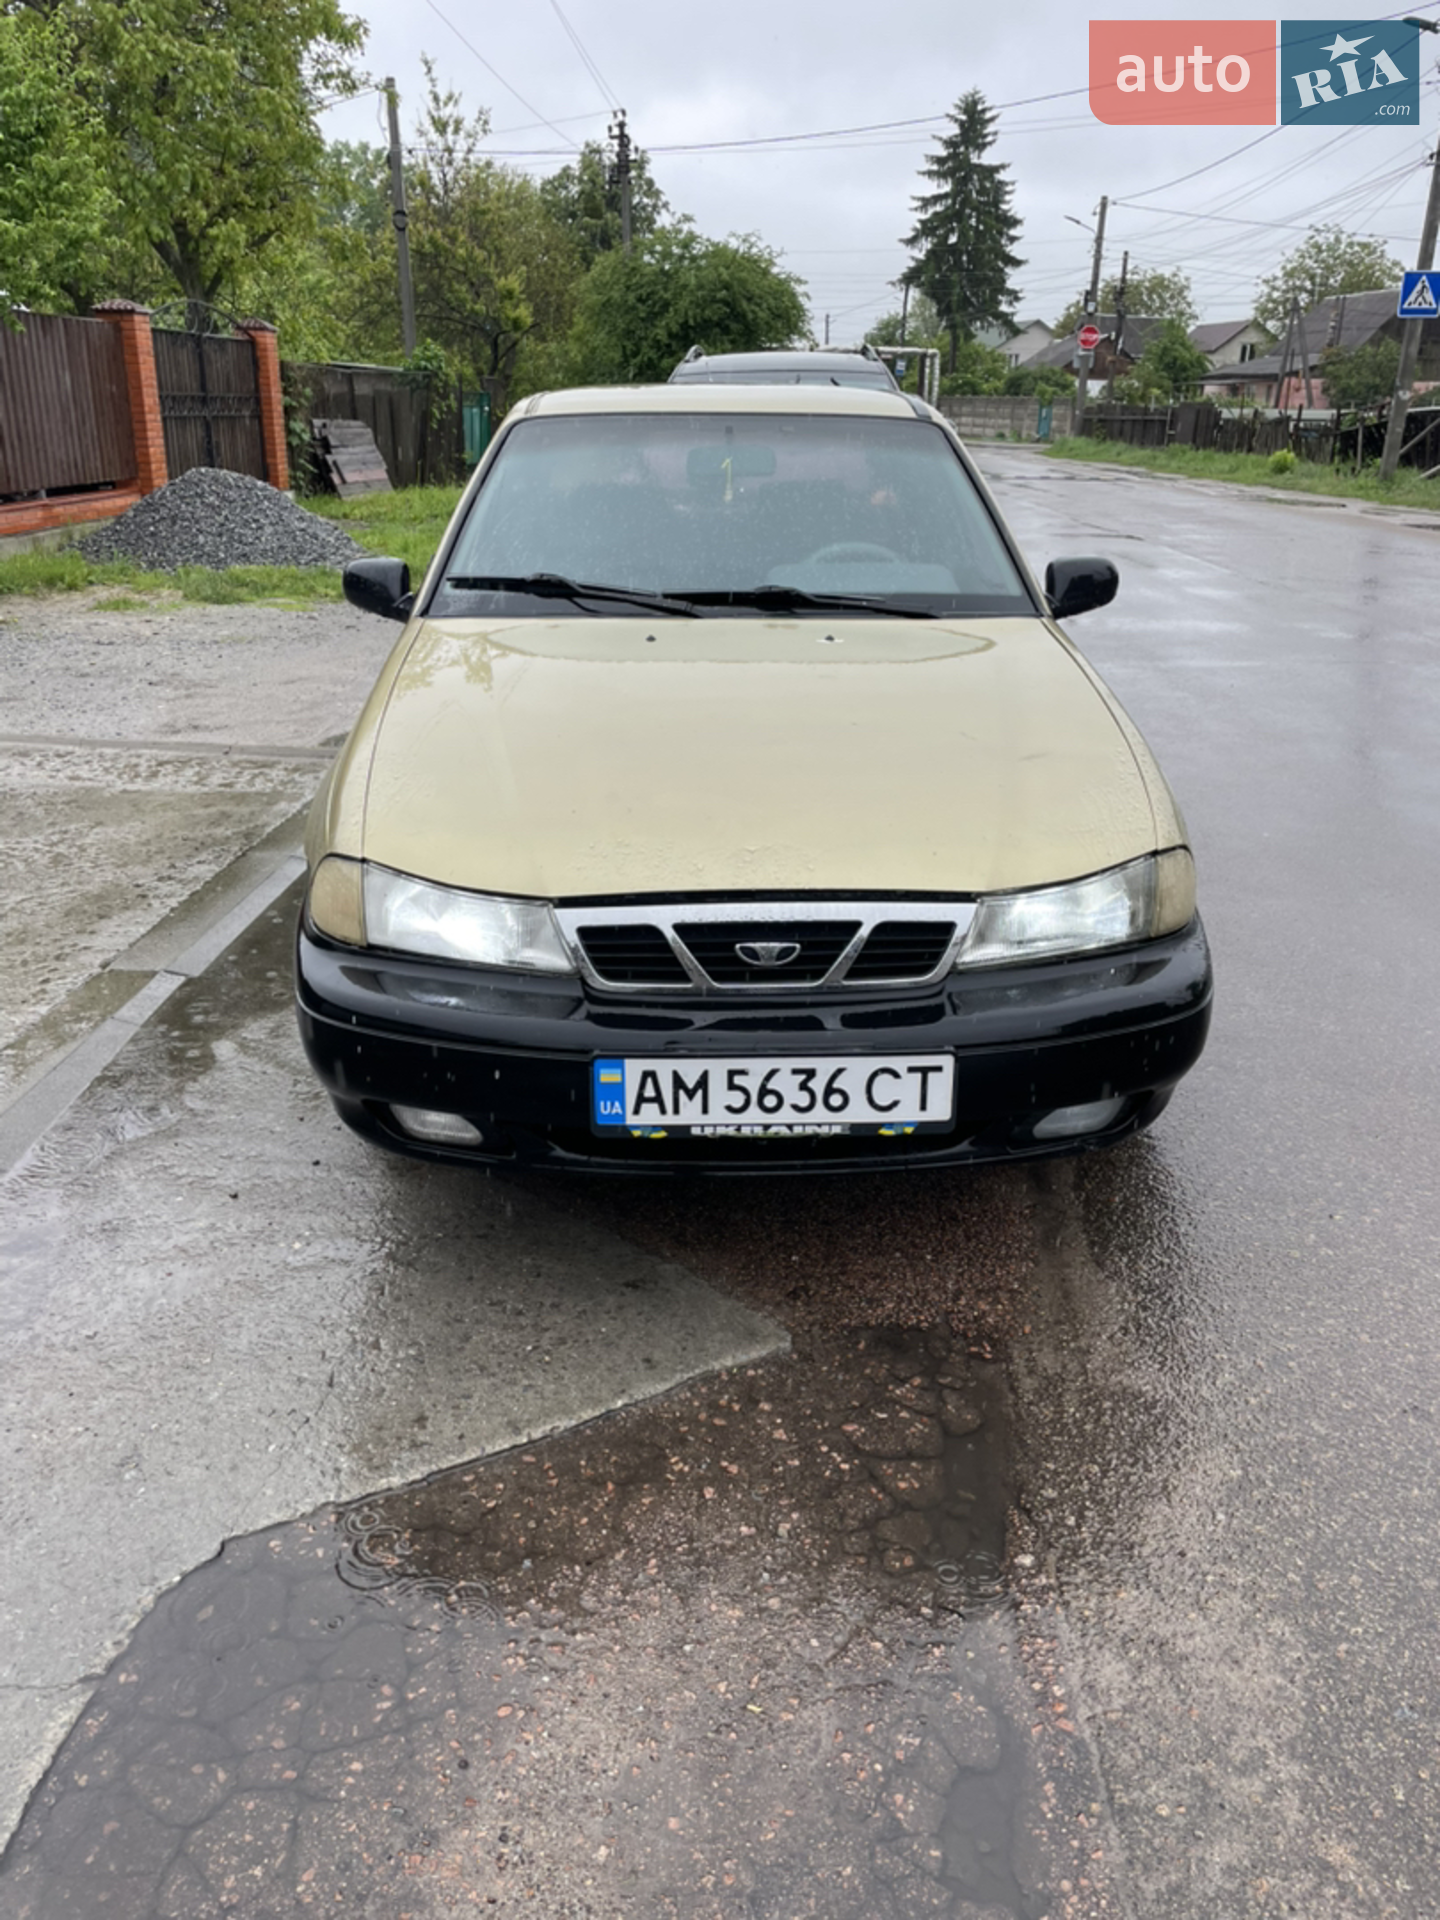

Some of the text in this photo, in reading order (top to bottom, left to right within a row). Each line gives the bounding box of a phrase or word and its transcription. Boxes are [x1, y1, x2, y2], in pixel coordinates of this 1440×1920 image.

[632, 1066, 943, 1115] AM 5636 CT
[600, 1100, 623, 1115] UA
